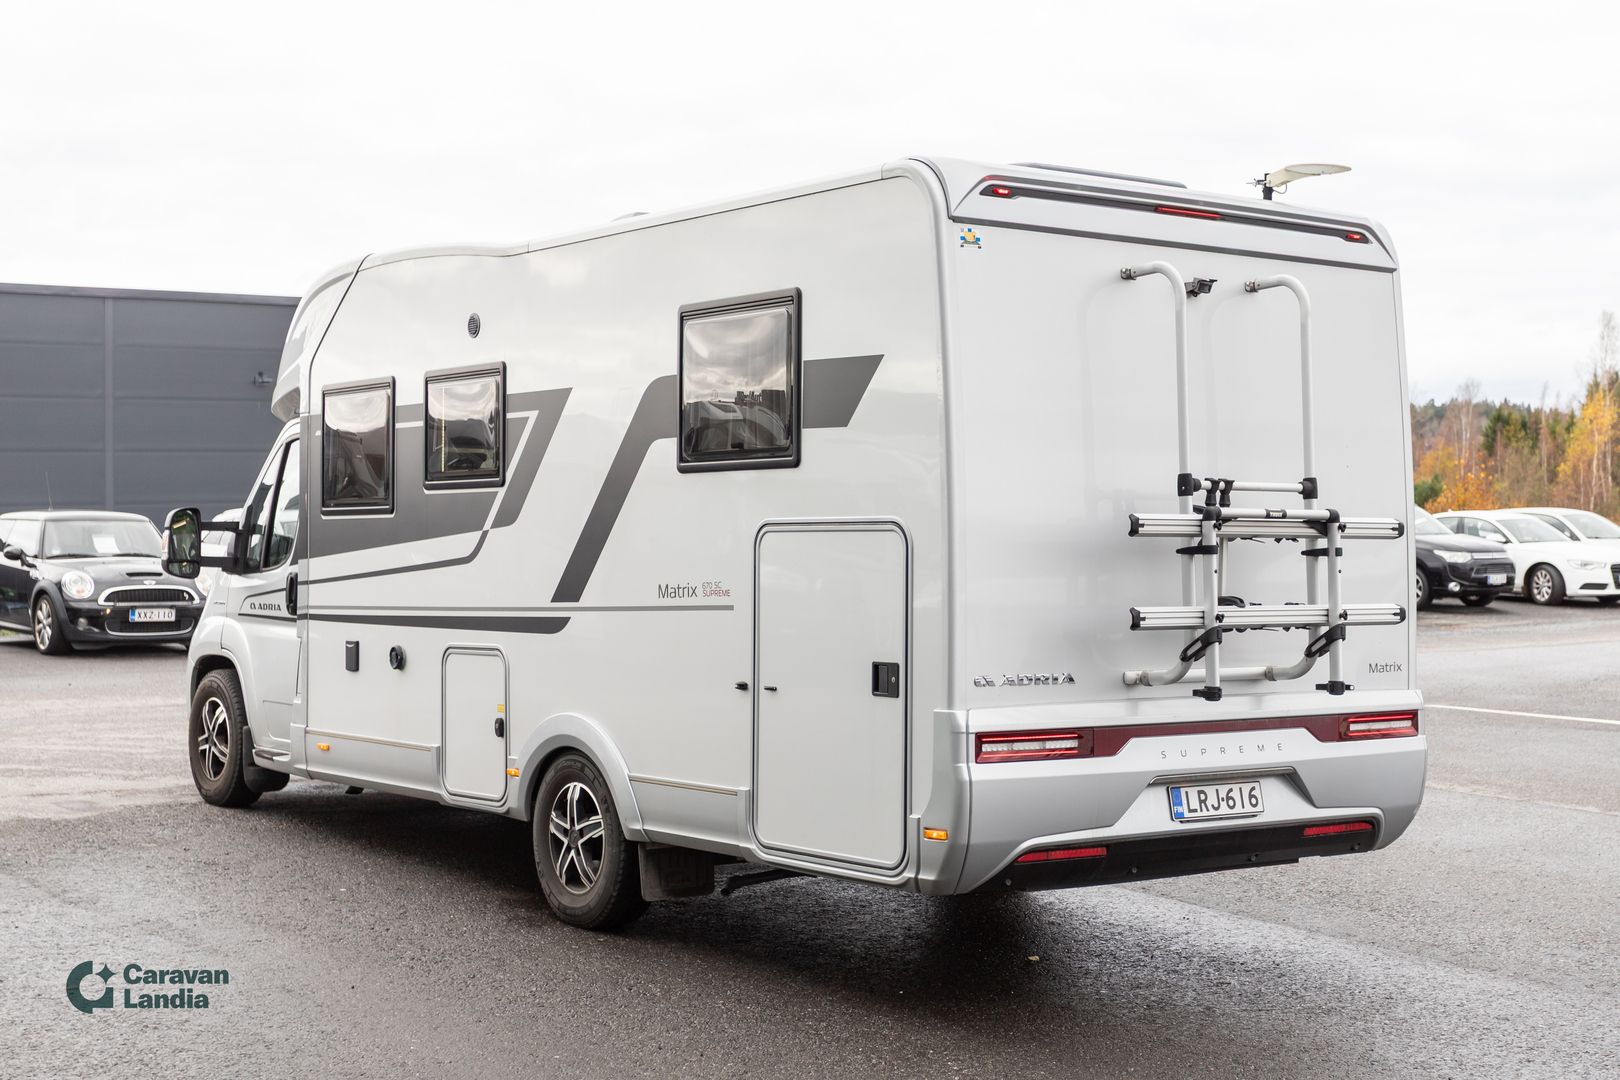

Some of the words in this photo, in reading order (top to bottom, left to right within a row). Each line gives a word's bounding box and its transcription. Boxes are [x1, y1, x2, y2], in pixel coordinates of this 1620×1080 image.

[658, 582, 698, 599] Matrix
[701, 581, 713, 589] 670
[713, 581, 722, 589] SC
[702, 589, 731, 597] SUPREME
[257, 603, 282, 611] ADRIA
[1368, 661, 1403, 674] Matrix
[999, 672, 1076, 687] ADRIA
[1161, 743, 1283, 759] SUPREME
[1184, 785, 1259, 814] LRJ-616
